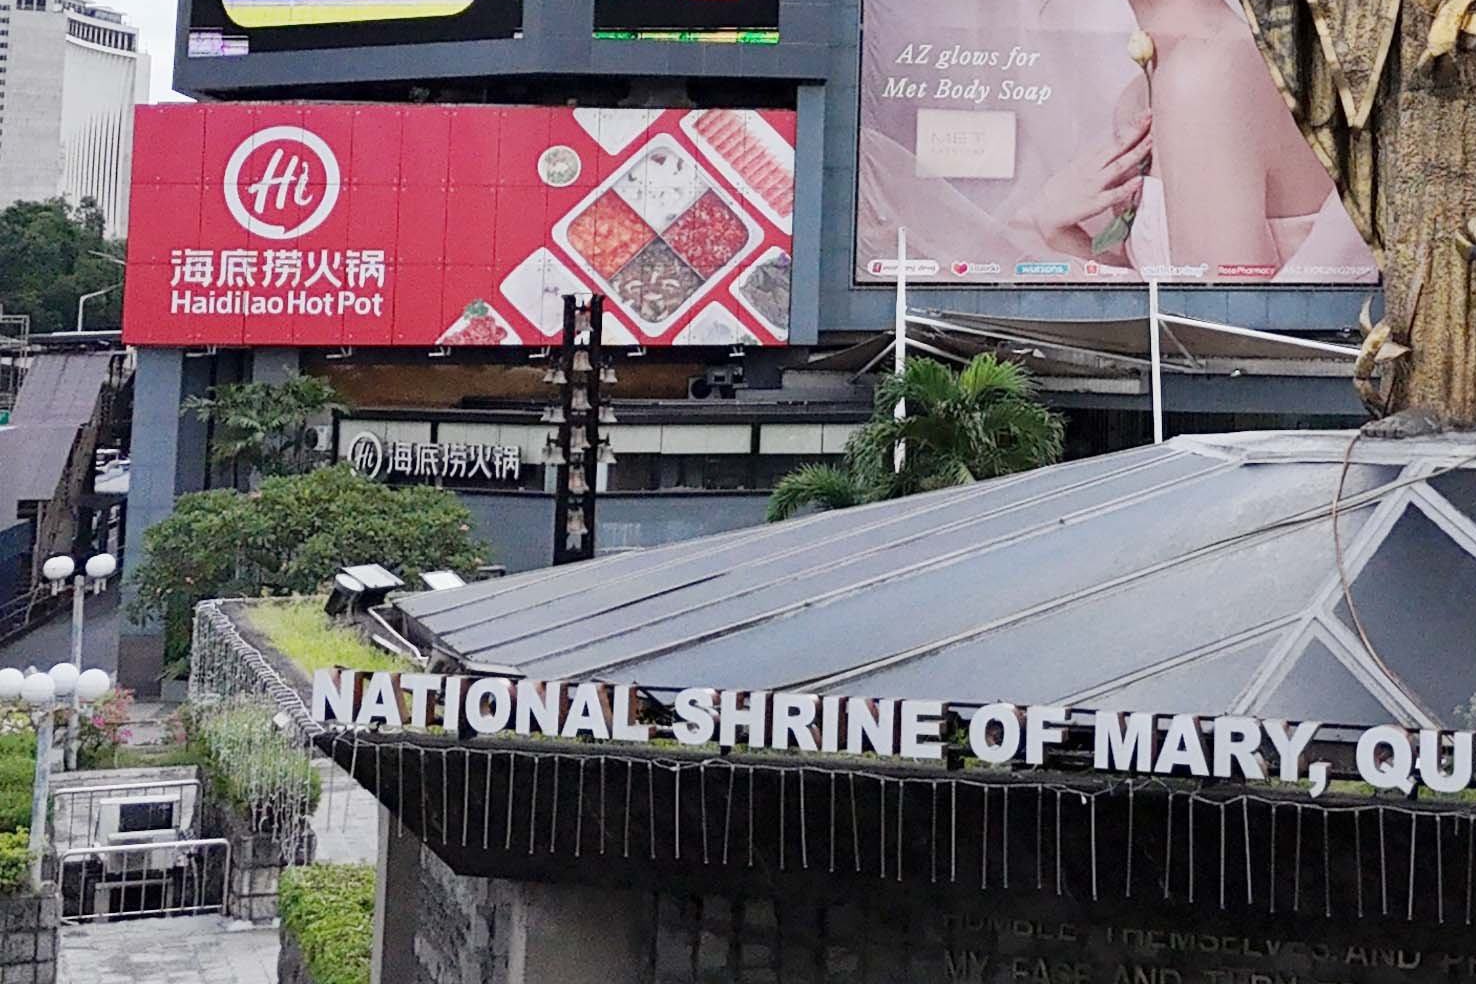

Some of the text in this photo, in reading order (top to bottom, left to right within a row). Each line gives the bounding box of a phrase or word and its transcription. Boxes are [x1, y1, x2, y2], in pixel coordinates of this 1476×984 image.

[895, 44, 1041, 71] AZ glows for
[882, 76, 1052, 104] Met Body Soap
[248, 149, 314, 214] Hi
[170, 249, 386, 288] 海底捞火锅
[170, 290, 384, 317] Haidilao Hot Pot
[386, 440, 520, 481] 海底捞火锅
[313, 668, 650, 742] NATIONAL
[672, 687, 946, 761] SHRINE
[967, 702, 1066, 766] OF
[1095, 711, 1328, 798] MARY,
